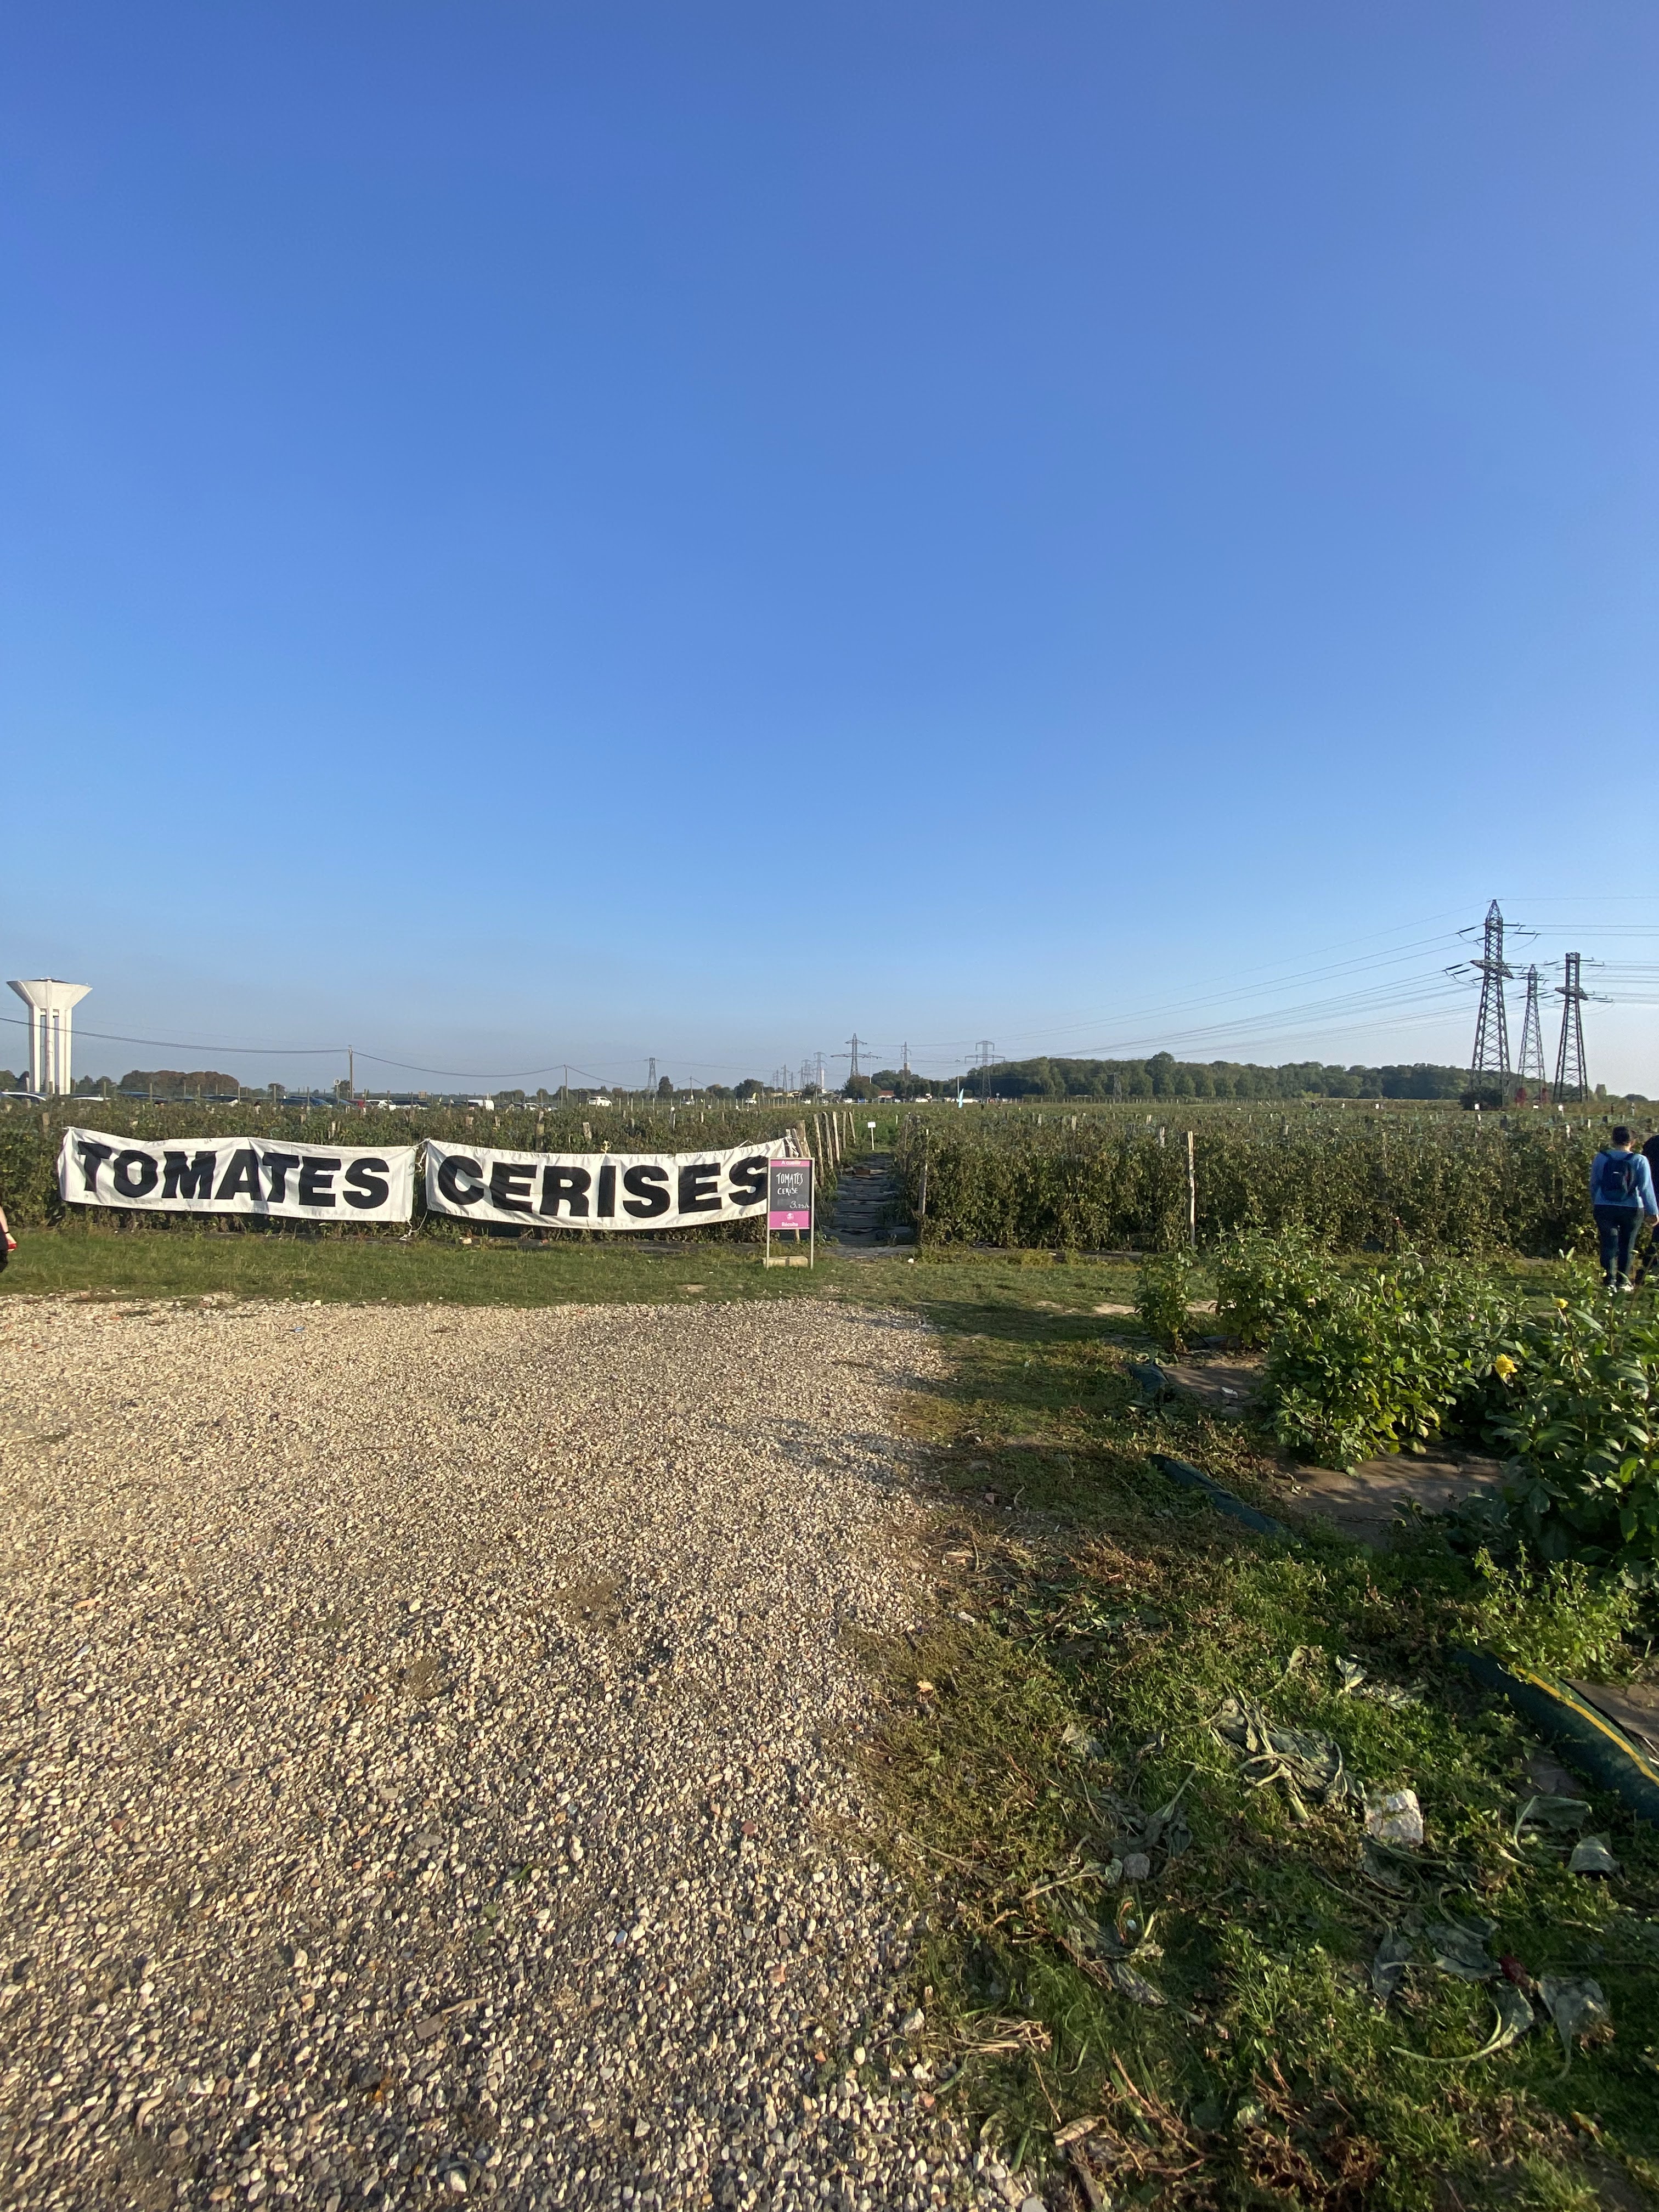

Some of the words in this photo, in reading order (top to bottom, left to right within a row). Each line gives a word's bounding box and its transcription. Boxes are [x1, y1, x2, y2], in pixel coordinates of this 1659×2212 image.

[78, 1141, 390, 1209] TOMATES
[438, 1155, 768, 1218] CERISES
[776, 1172, 803, 1187] TOMATES
[777, 1187, 799, 1196] CERISE
